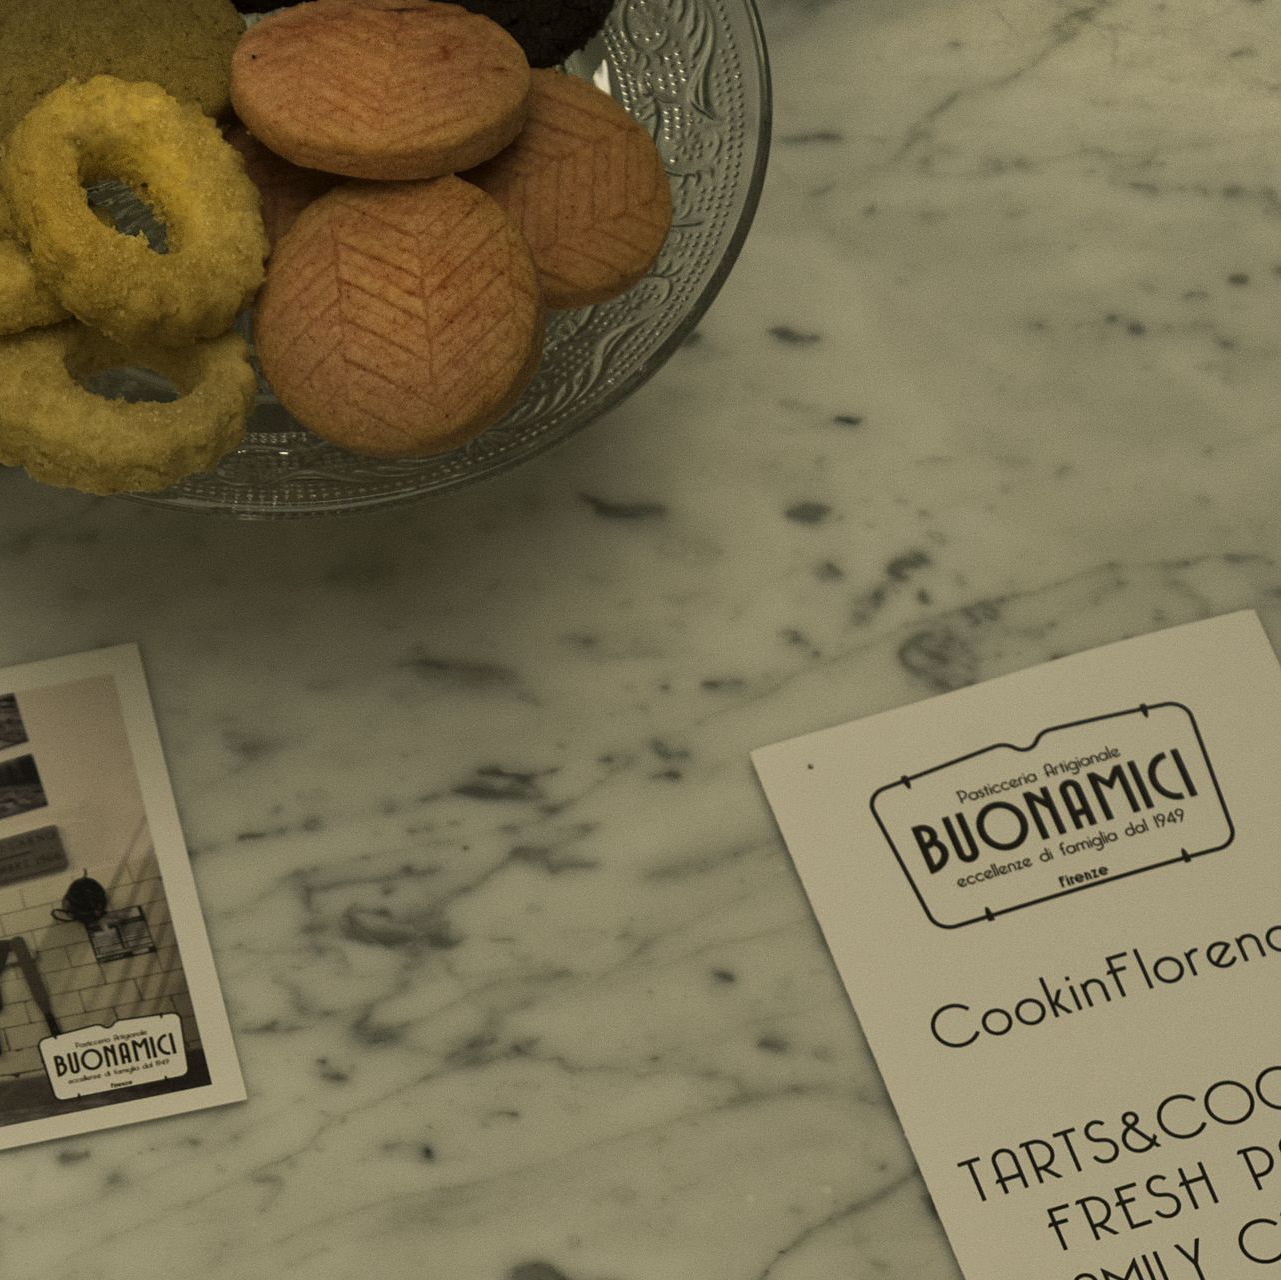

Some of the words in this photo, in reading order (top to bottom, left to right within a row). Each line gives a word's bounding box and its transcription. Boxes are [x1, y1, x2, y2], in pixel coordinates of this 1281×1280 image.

[956, 771, 1038, 804] Pasticceria
[1043, 744, 1121, 779] Artigianale
[911, 749, 1198, 874] BUONAMICI
[957, 854, 1032, 888] eccellenze
[1039, 847, 1055, 863] di
[1059, 828, 1119, 858] famiglia
[1124, 819, 1149, 842] dal
[1152, 808, 1186, 831] 1949
[1058, 864, 1109, 888] Firenze
[53, 1032, 178, 1078] BUONAMICI
[1046, 1161, 1220, 1252] FRESH
[1237, 1136, 1281, 1191] P
[1238, 1211, 1281, 1264] C
